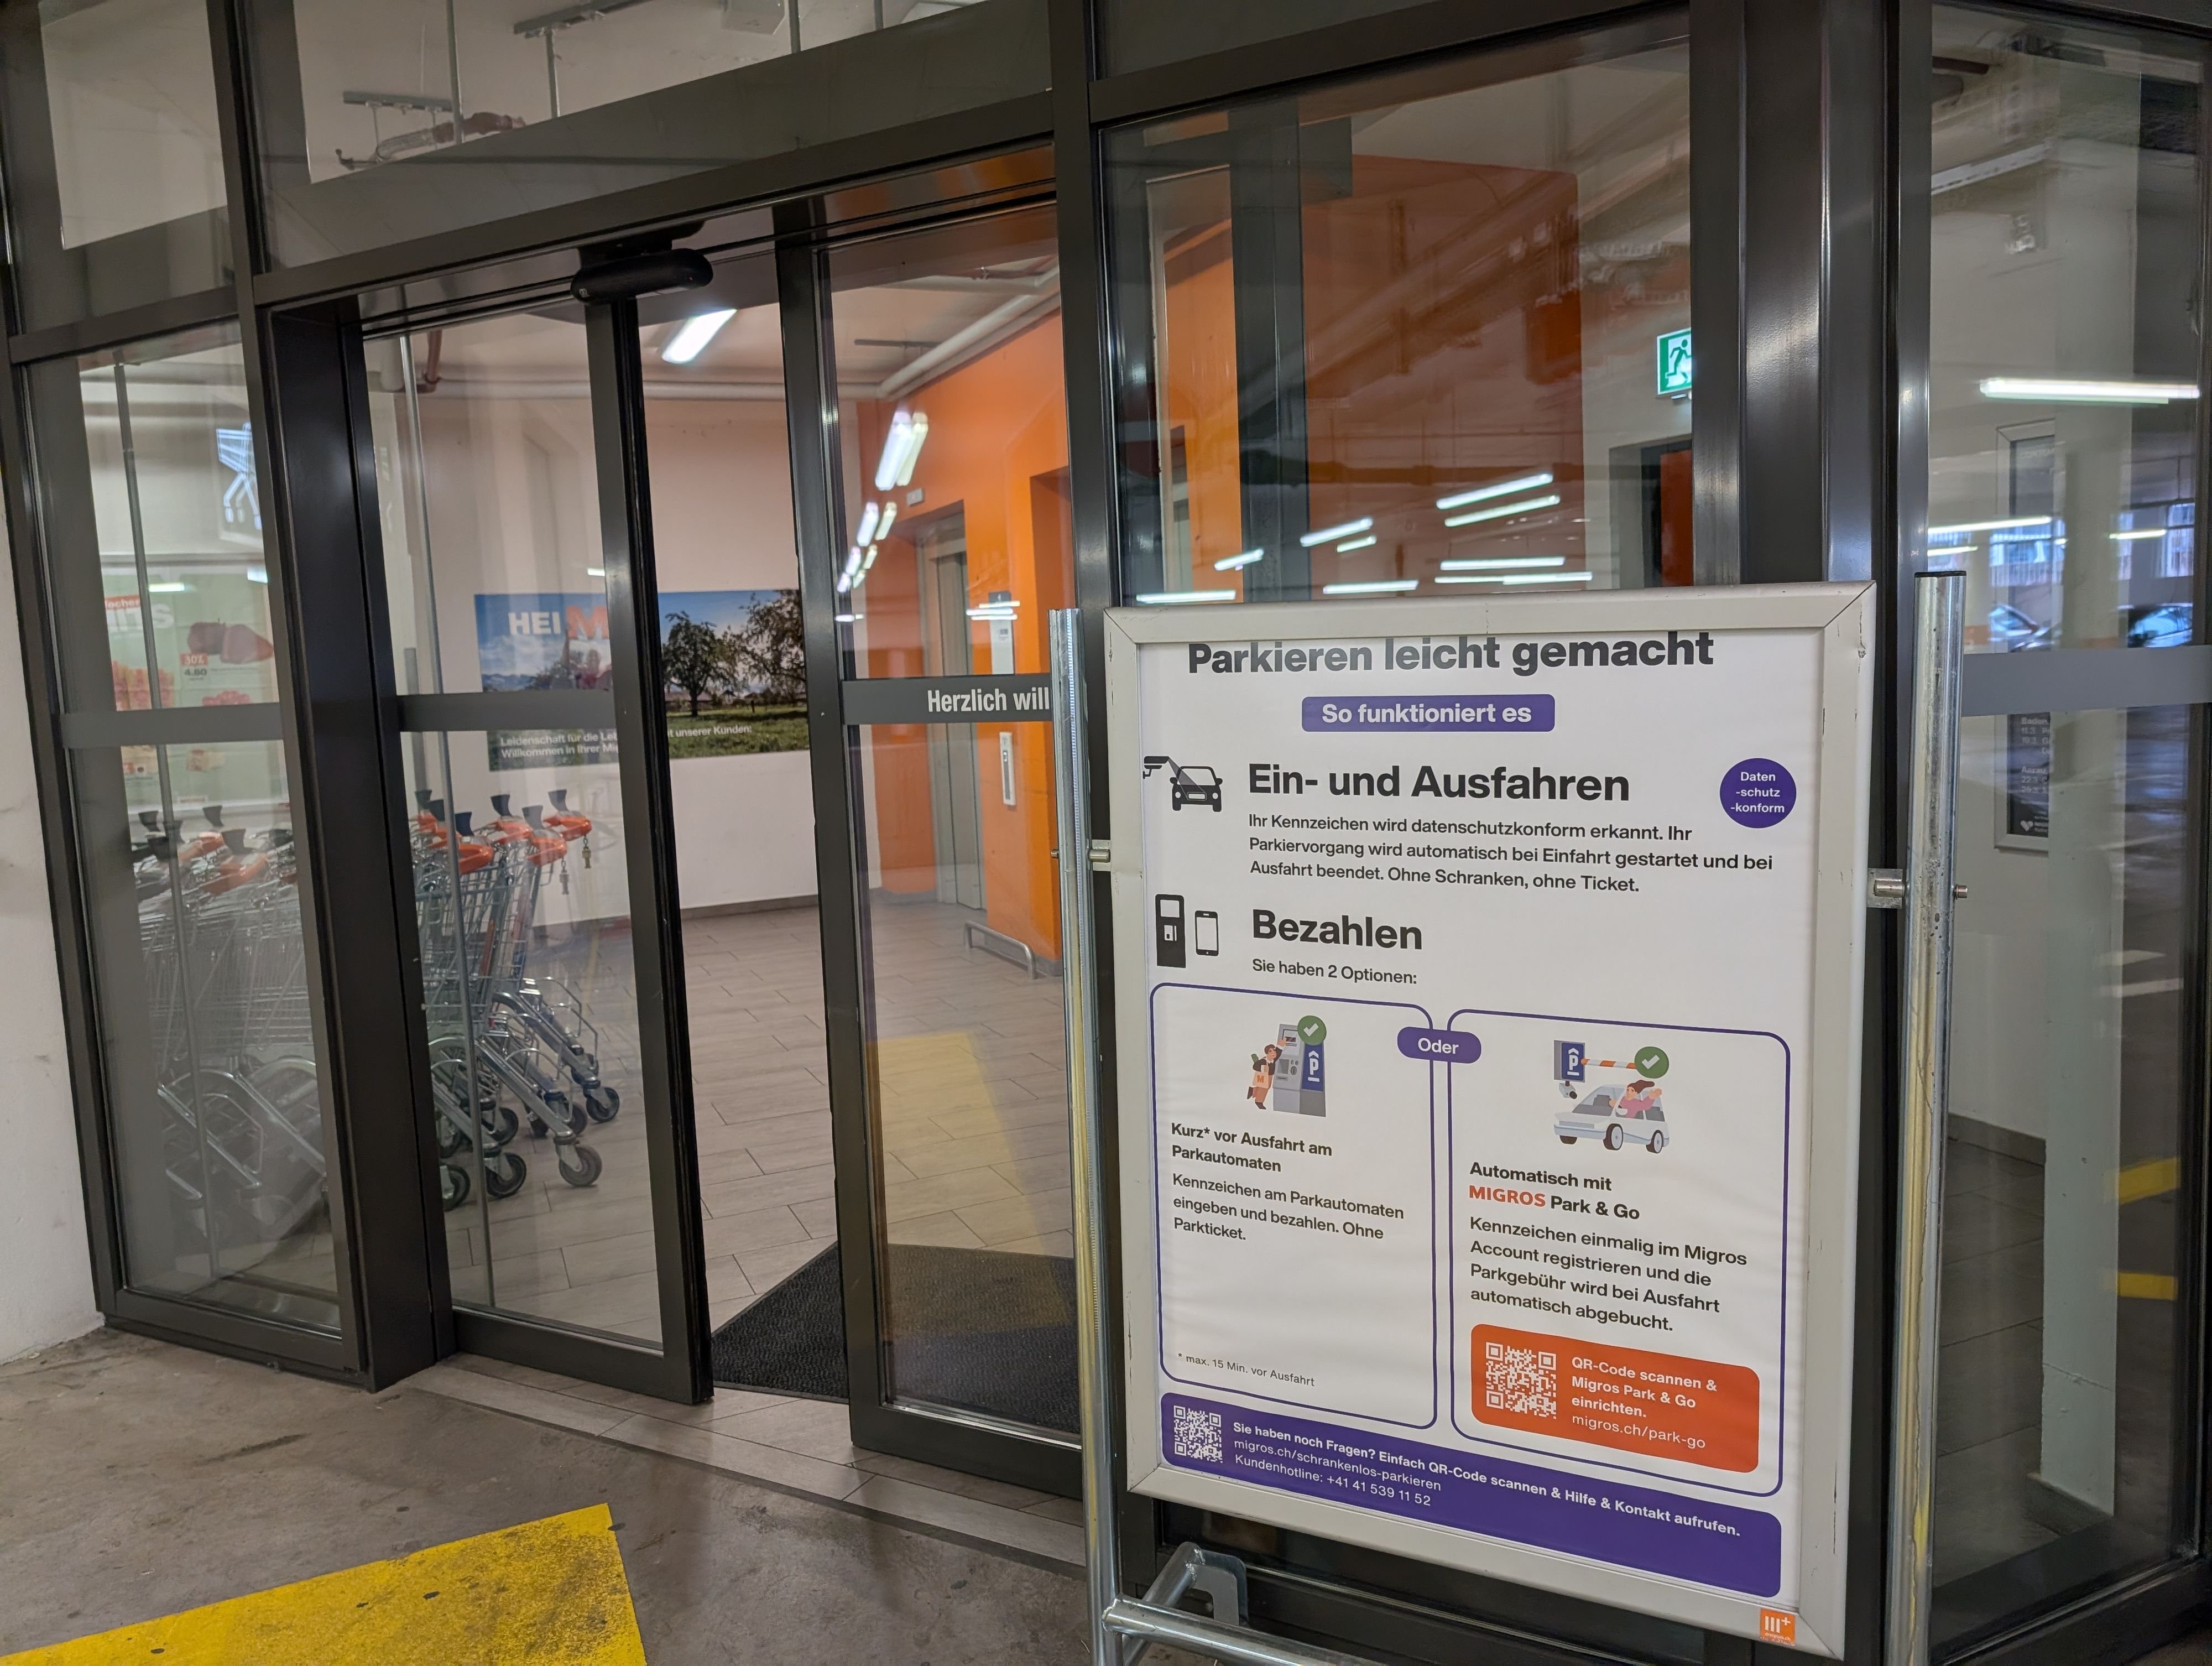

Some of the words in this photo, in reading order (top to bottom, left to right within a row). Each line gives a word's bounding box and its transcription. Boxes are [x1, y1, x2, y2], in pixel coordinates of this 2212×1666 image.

[1189, 641, 1372, 674] Parkieren
[1385, 637, 1500, 670] leicht
[1512, 632, 1714, 676] gemacht
[928, 689, 1006, 712] Herzlich
[1013, 687, 1049, 710] will
[1322, 704, 1352, 722] So
[1358, 704, 1495, 722] funktioniert
[1503, 707, 1531, 722] es
[500, 734, 566, 746] Leidenschaft
[583, 732, 598, 742] die
[676, 727, 711, 737] unserer
[501, 747, 564, 758] Willkommen
[566, 745, 575, 754] in
[577, 744, 599, 753] Ihrer
[1249, 764, 1318, 794] Ein-
[1329, 766, 1399, 796] und
[1411, 766, 1629, 801] Ausfahren
[1736, 788, 1780, 796] -schutz
[1741, 772, 1775, 781] Daten
[1731, 803, 1785, 813] -konform
[1250, 814, 1267, 827] Ihr
[1272, 815, 1368, 830] Kennzeichen
[1373, 819, 1407, 831] wird
[1412, 819, 1585, 837] datenschutzkonform
[1590, 824, 1663, 840] erkannt.
[1669, 826, 1692, 840] Ihr
[1250, 837, 1364, 858] Parkiervorgang
[1368, 843, 1402, 856] wird
[1407, 845, 1507, 860] automatisch
[1512, 847, 1537, 861] bei
[1543, 848, 1610, 864] Einfahrt
[1615, 853, 1698, 868] gestartet
[1704, 855, 1738, 868] und
[1744, 855, 1772, 870] bei
[1250, 861, 1312, 876] Ausfahrt
[1317, 864, 1384, 879] beendet.
[1388, 867, 1431, 882] Ohne
[1435, 870, 1528, 889] Schranken,
[1533, 874, 1576, 888] ohne
[1580, 876, 1639, 892] Ticket.
[1253, 909, 1422, 950] Bezahlen
[1253, 959, 1275, 972] Sie
[1279, 961, 1323, 977] haben
[1328, 965, 1337, 978] 2
[1341, 966, 1416, 984] Optionen:
[1418, 1038, 1459, 1054] Oder
[1172, 1145, 1281, 1172] Parkautomaten
[1214, 1131, 1237, 1143] vor
[1241, 1132, 1305, 1152] Ausfahrt
[1309, 1144, 1332, 1156] am
[1470, 1162, 1578, 1186] Automatisch
[1584, 1177, 1611, 1191] mit
[1173, 1173, 1260, 1198] Kennzeichen
[1265, 1190, 1286, 1202] am
[1291, 1191, 1404, 1219] Parkautomaten
[1470, 1185, 1545, 1206] MIGROS
[1551, 1196, 1590, 1214] Park
[1595, 1201, 1609, 1216] &
[1614, 1204, 1640, 1219] Go
[1173, 1197, 1237, 1216] eingeben
[1241, 1209, 1266, 1221] und
[1271, 1210, 1339, 1232] bezahlen.
[1343, 1222, 1383, 1239] Ohne
[1175, 1217, 1245, 1240] Parkticket.
[1471, 1217, 1576, 1243] Kennzeichen
[1582, 1233, 1653, 1256] einmalig
[1659, 1242, 1679, 1257] im
[1685, 1245, 1746, 1265] Migros
[1470, 1241, 1538, 1262] Account
[1544, 1253, 1641, 1276] registrieren
[1647, 1267, 1679, 1282] und
[1684, 1271, 1711, 1286] die
[1472, 1263, 1566, 1290] Parkgebühr
[1571, 1281, 1607, 1297] wird
[1613, 1285, 1638, 1301] bei
[1643, 1289, 1719, 1313] Ausfahrt
[1471, 1290, 1571, 1315] automatisch
[1575, 1305, 1672, 1331] abgebucht.
[1186, 1356, 1209, 1366] max.
[1212, 1360, 1223, 1368] 15
[1227, 1362, 1248, 1373] Min.
[1251, 1368, 1267, 1376] vor
[1270, 1370, 1314, 1386] Ausfahrt
[1572, 1357, 1635, 1378] QR-Code
[1640, 1372, 1700, 1388] scannen
[1706, 1380, 1717, 1391] &
[1572, 1376, 1619, 1393] Migros
[1624, 1385, 1655, 1401] Park
[1660, 1392, 1671, 1403] &
[1675, 1394, 1695, 1408] Go
[1572, 1396, 1646, 1417] einrichten.
[1573, 1416, 1705, 1449] migros.ch/park-go
[1234, 1440, 1441, 1491] migros.ch/schrankenlos-parkieren
[1234, 1423, 1251, 1434] Sie
[1255, 1426, 1291, 1441] haben
[1295, 1435, 1322, 1448] noch
[1327, 1440, 1375, 1459] Fragen?
[1379, 1451, 1425, 1470] Einfach
[1429, 1462, 1486, 1482] QR-Code
[1491, 1477, 1546, 1496] scannen
[1551, 1487, 1561, 1499] &
[1566, 1490, 1596, 1506] Hilfe
[1601, 1498, 1611, 1509] &
[1615, 1501, 1671, 1521] Kontakt
[1674, 1515, 1740, 1536] aufrufen.
[1235, 1454, 1322, 1482] Kundenhotline:
[1327, 1476, 1347, 1487] +41
[1353, 1481, 1365, 1491] 41
[1370, 1484, 1394, 1497] 539
[1399, 1490, 1409, 1501] 11
[1415, 1493, 1430, 1506] 52
